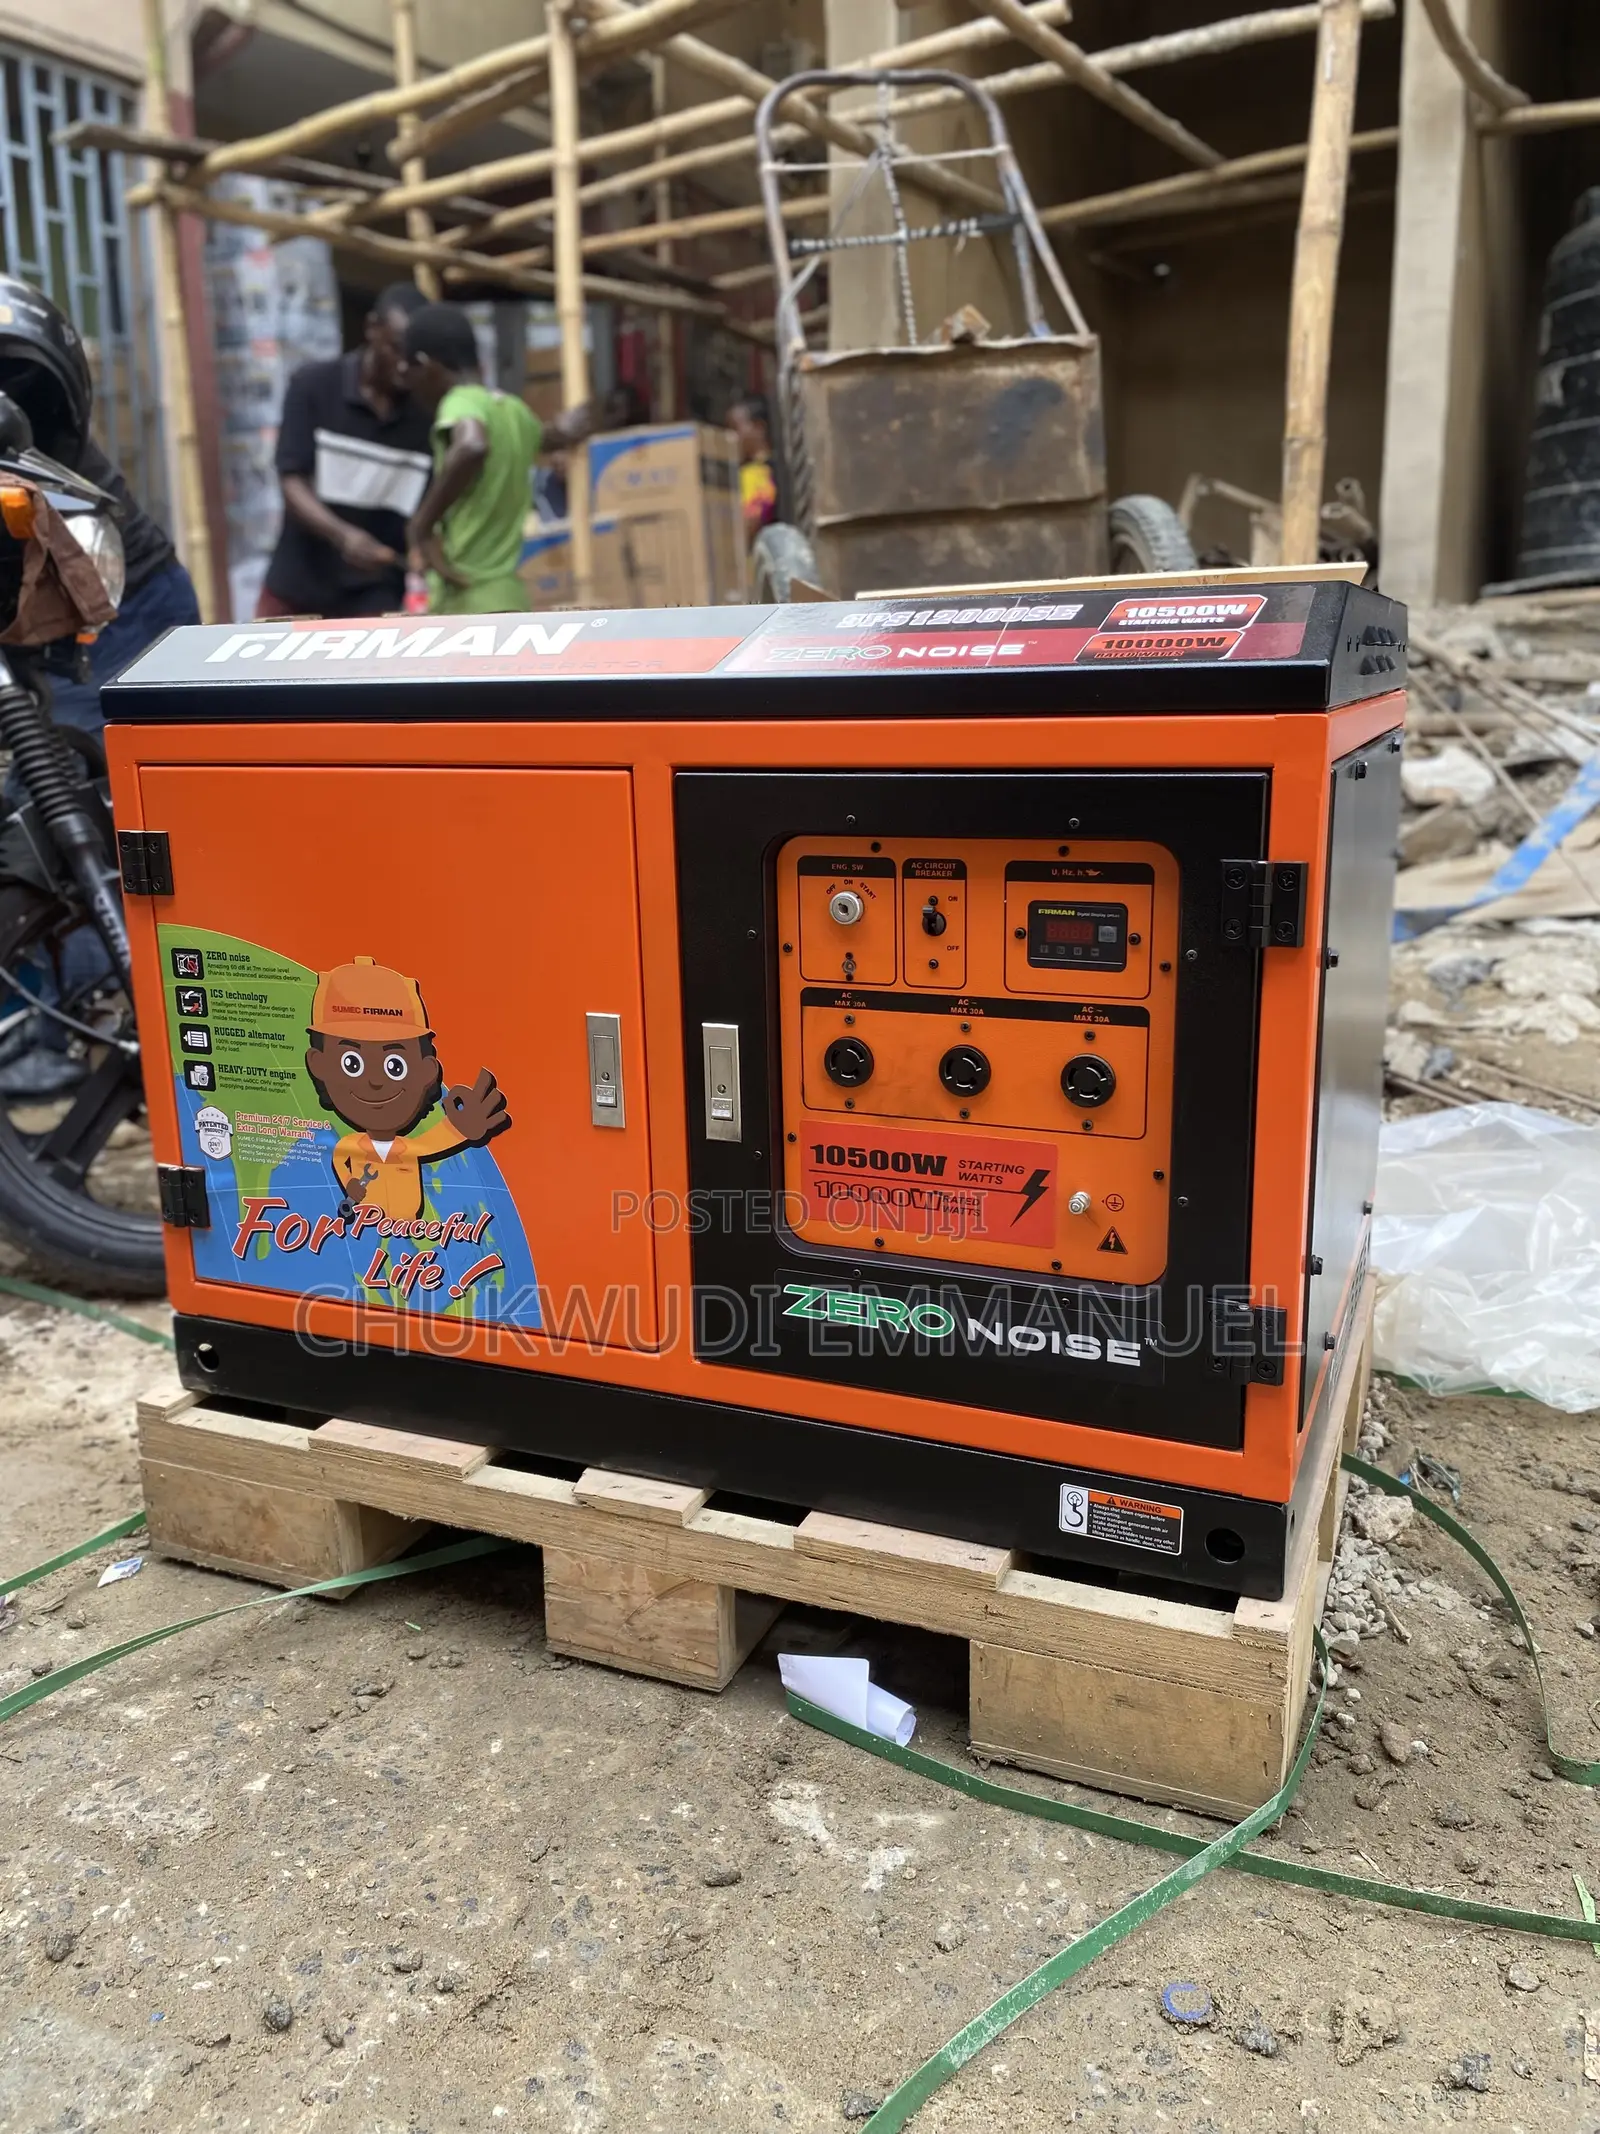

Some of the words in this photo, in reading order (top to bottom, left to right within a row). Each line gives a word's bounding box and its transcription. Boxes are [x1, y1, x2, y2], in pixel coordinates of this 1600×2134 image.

[835, 603, 1084, 629] SPS12000SE
[1125, 603, 1248, 619] 10500W
[1118, 617, 1180, 626] STARTING
[1181, 616, 1225, 624] WATTS
[204, 623, 586, 663] FIRMAN
[1102, 636, 1228, 649] 10000W
[763, 645, 892, 662] ZERO
[897, 643, 1026, 658] NOISE
[924, 862, 957, 870] CIRCUIT
[826, 884, 836, 895] OFF
[860, 882, 876, 900] START
[1038, 908, 1075, 916] FIRMAN
[206, 950, 227, 961] ZERO
[229, 953, 250, 962] noise
[210, 989, 223, 998] ICS
[225, 990, 268, 1003] technology
[332, 1005, 361, 1014] SUMEC
[363, 1007, 403, 1016] FIRMAN
[1073, 1014, 1092, 1022] MAX
[1094, 1015, 1110, 1023] 30A
[214, 1026, 246, 1037] RUGGED
[247, 1029, 285, 1041] alternator
[218, 1063, 267, 1077] HEAVY-DUTY
[269, 1070, 296, 1081] engine
[198, 1121, 229, 1131] PATENTED
[235, 1111, 271, 1124] Premium
[272, 1115, 290, 1126] 24/7
[293, 1117, 323, 1129] Service
[323, 1120, 331, 1130] &
[236, 1122, 256, 1133] Extra
[258, 1125, 277, 1138] Long
[279, 1127, 315, 1141] Warranty
[810, 1144, 947, 1177] 10500W
[958, 1159, 1025, 1175] STARTING
[958, 1171, 1003, 1185] WATTS
[814, 1180, 942, 1211] 10000W
[943, 1194, 980, 1206] RATED
[942, 1205, 981, 1217] WATTS
[232, 1197, 344, 1259] For
[350, 1204, 494, 1248] Peaceful
[782, 1284, 955, 1338] ZERO
[967, 1318, 1141, 1367] NOISE
[1093, 1503, 1110, 1511] Always
[1135, 1511, 1150, 1519] engine
[1150, 1514, 1165, 1522] before
[1120, 1498, 1161, 1514] WARNING
[1107, 1516, 1127, 1525] transport
[1128, 1520, 1149, 1529] generator
[1117, 1529, 1138, 1538] forbidden
